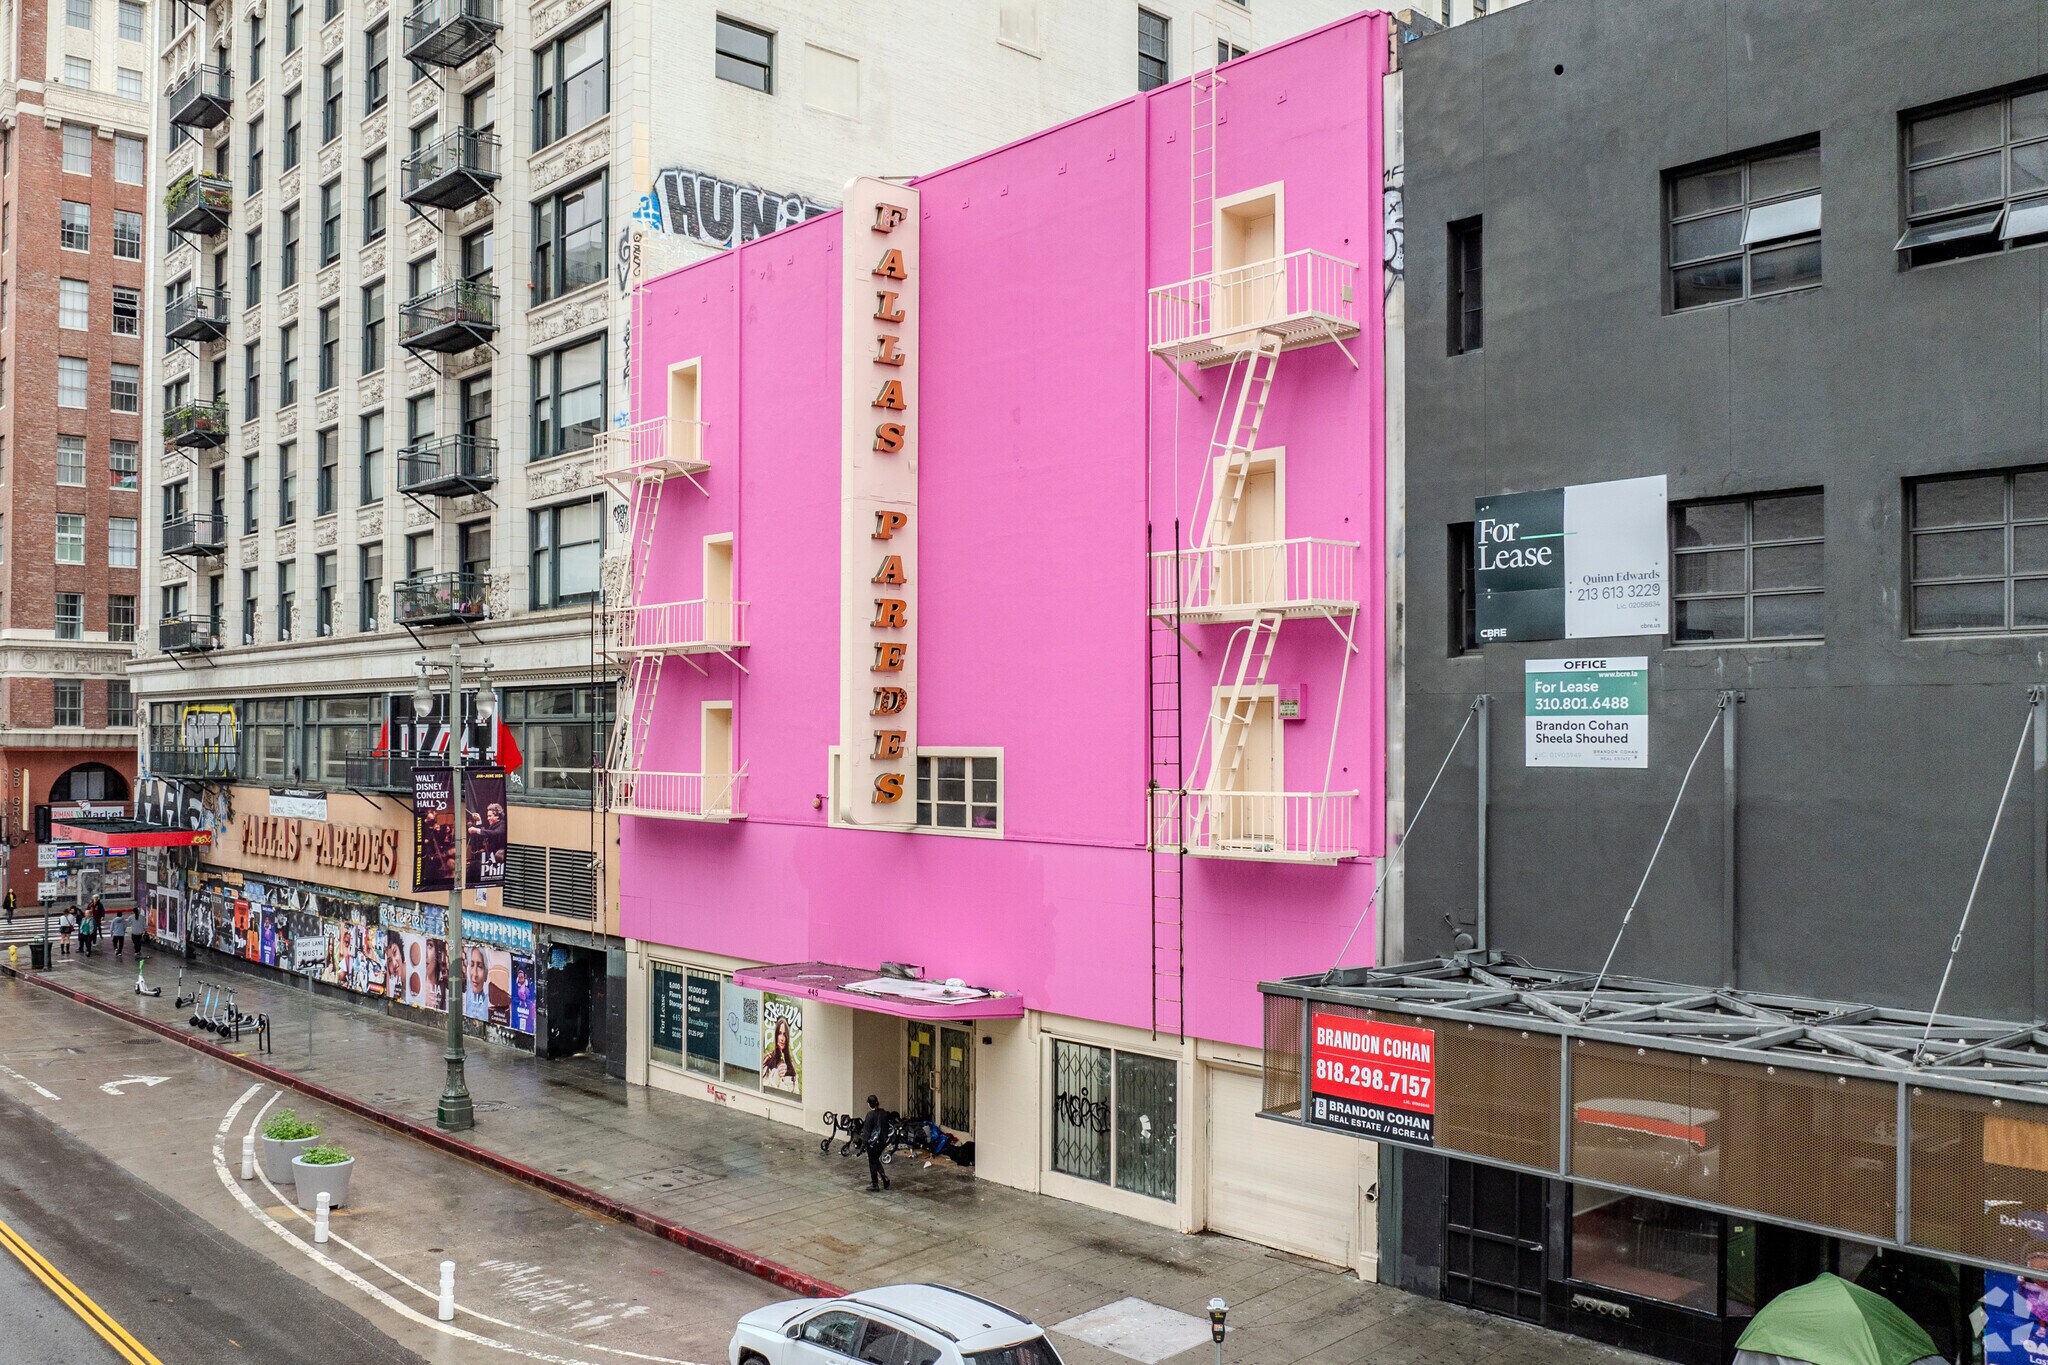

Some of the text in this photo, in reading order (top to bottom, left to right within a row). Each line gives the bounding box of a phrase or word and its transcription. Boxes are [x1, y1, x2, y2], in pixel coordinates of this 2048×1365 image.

[871, 202, 908, 454] FALLAS
[1478, 518, 1520, 545] For
[1478, 545, 1553, 571] Lease
[1582, 569, 1660, 585] Quinn Edwards
[1577, 583, 1661, 602] 213 613 3229
[1480, 628, 1507, 638] CBRE
[869, 510, 908, 804] PAREDES
[1563, 659, 1607, 670] OFFICE
[1598, 670, 1638, 678] www.bcre.la
[1535, 680, 1599, 693] For Lease
[1535, 696, 1629, 710] 310.801.6488
[1536, 720, 1629, 731] Brandon Cohan
[1535, 733, 1628, 744] Sheela Shouhed
[415, 774, 435, 782] WALT
[416, 783, 442, 791] DISNEY
[416, 791, 449, 799] CONCERT
[417, 800, 435, 808] HALL
[242, 815, 302, 861] FALLAS
[315, 823, 399, 875] PAREDES
[481, 852, 496, 864] LA
[480, 862, 504, 876] Phil
[302, 949, 318, 957] MUST
[669, 991, 681, 999] Floors
[693, 996, 704, 1004] Retail
[808, 988, 819, 997] 445
[669, 1000, 700, 1013] Storag Space
[1317, 1026, 1431, 1063] BRANDON COHAN
[1316, 1059, 1431, 1098] 818.298.7157
[1329, 1100, 1430, 1131] BRANDON COHAN
[1329, 1114, 1349, 1125] REAL
[1351, 1117, 1382, 1132] ESTATE
[1392, 1127, 1430, 1141] BCRE.LA
[2000, 1214, 2045, 1232] DANCE
